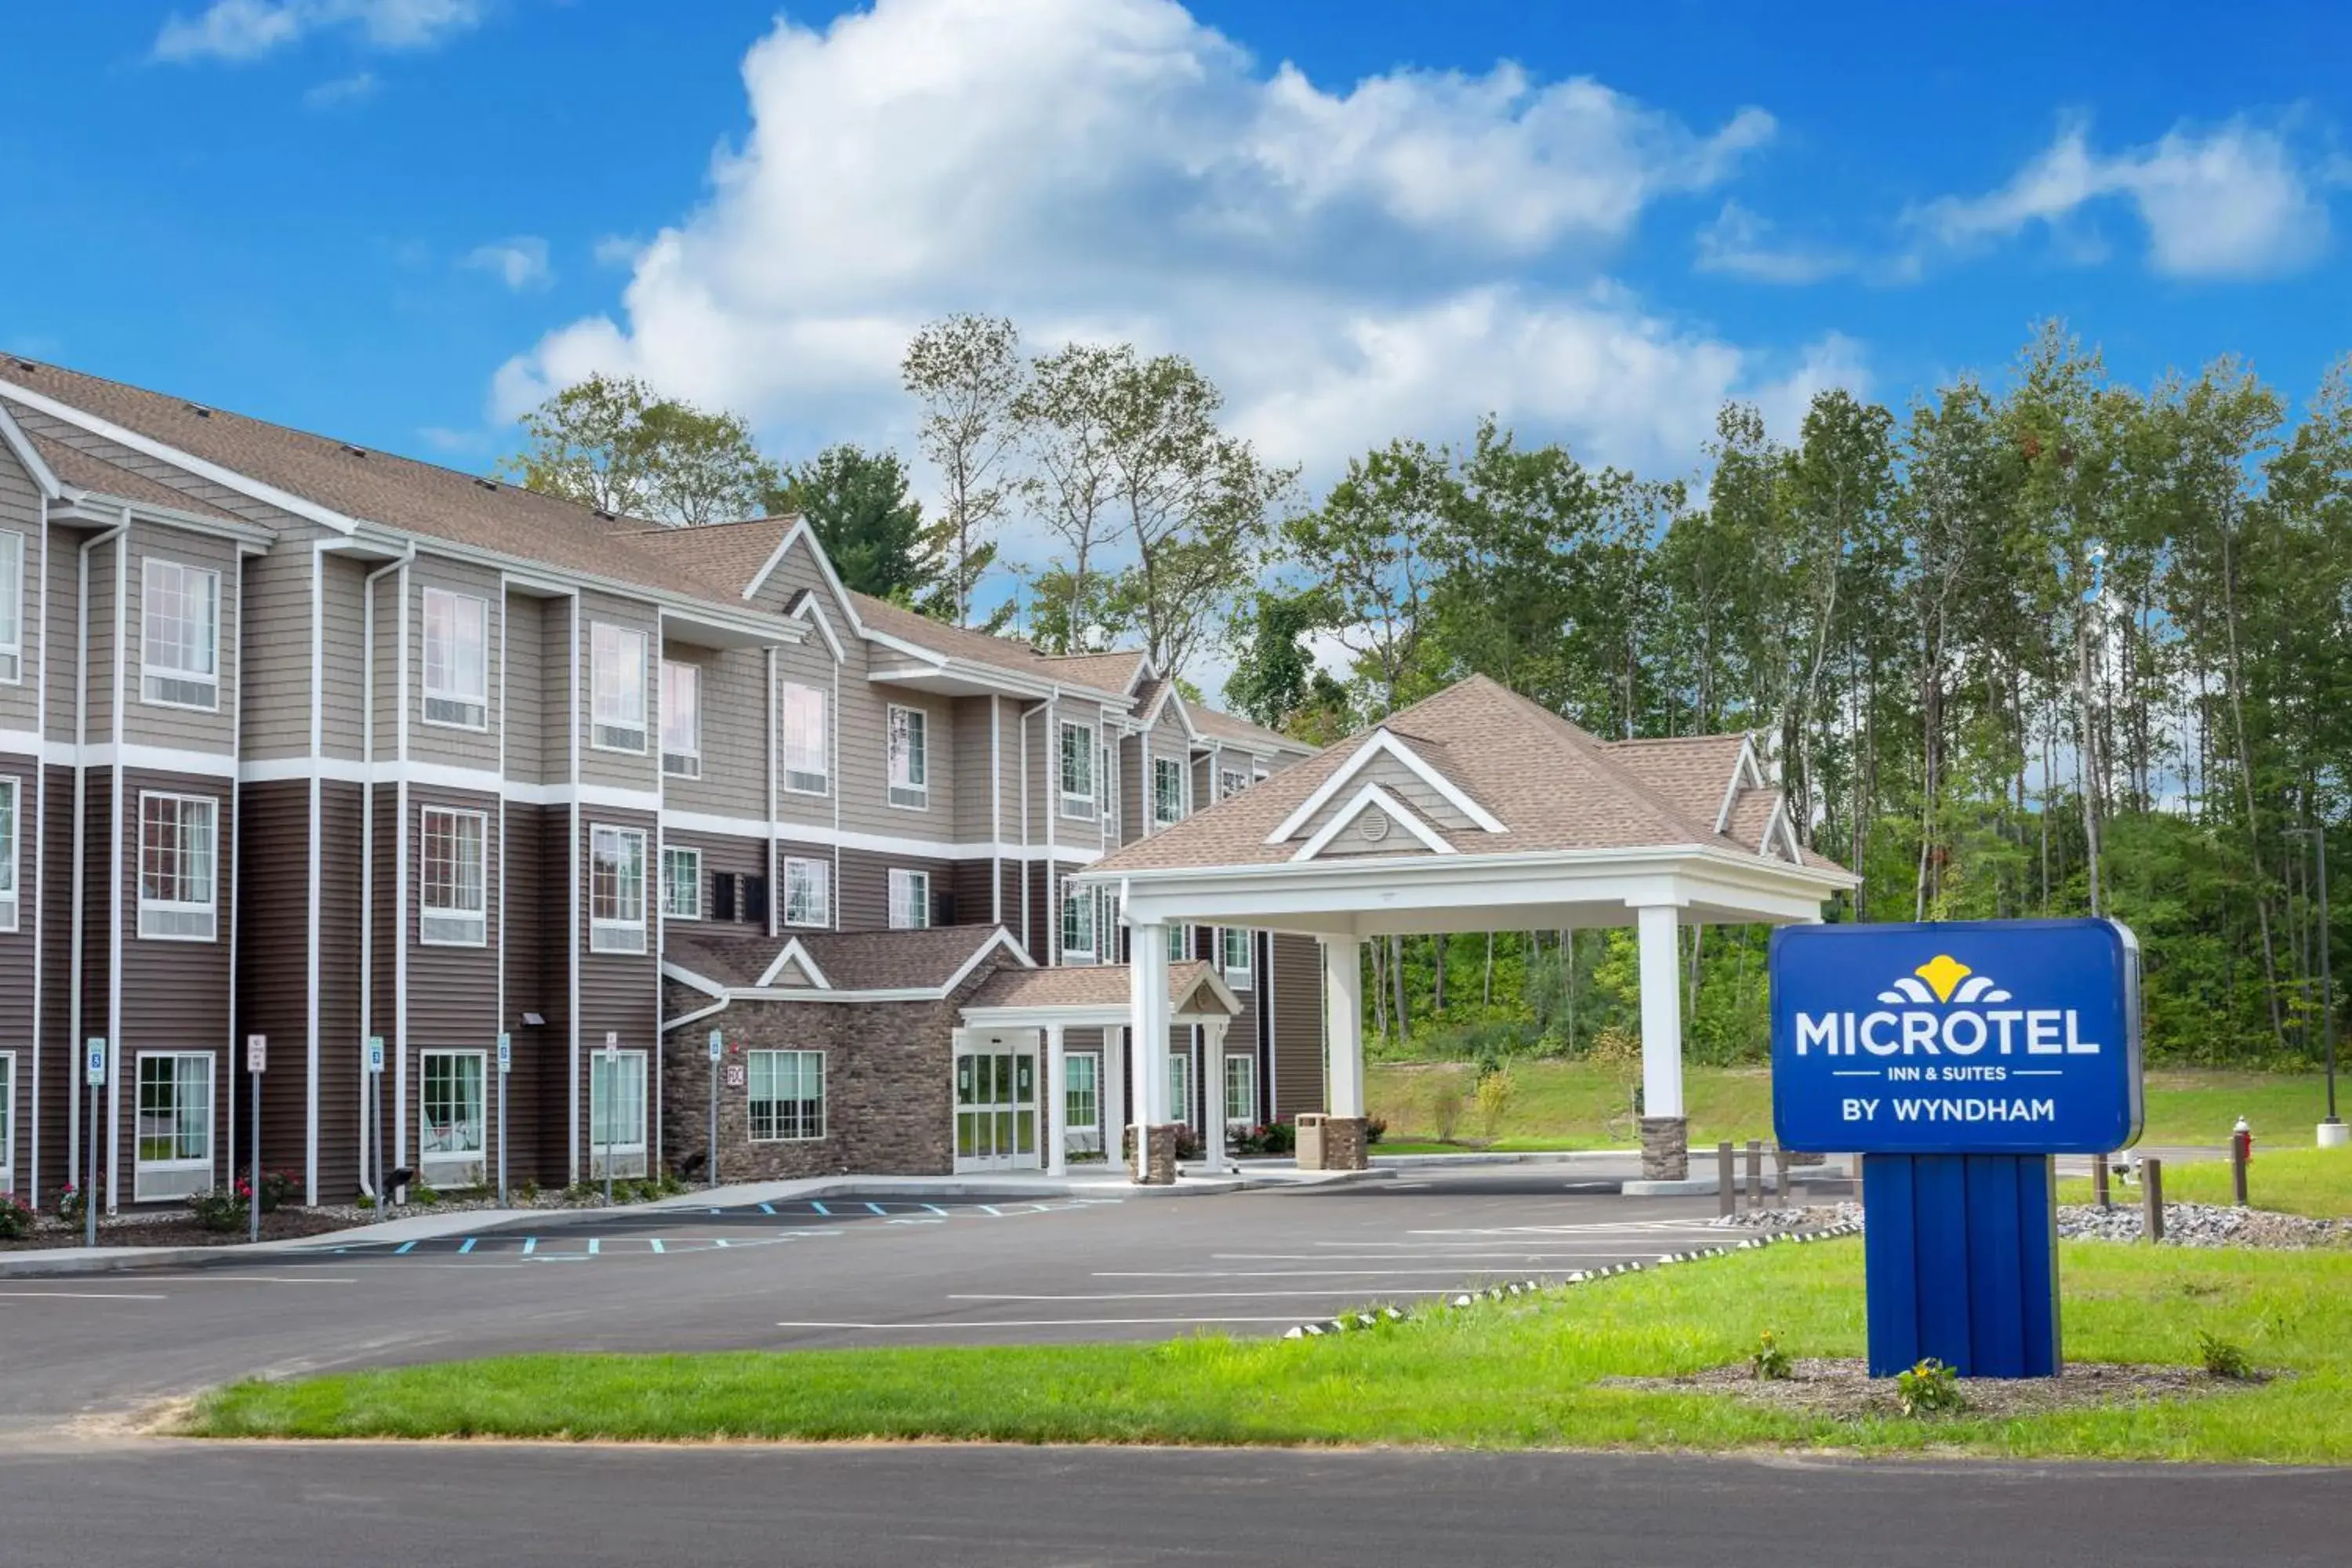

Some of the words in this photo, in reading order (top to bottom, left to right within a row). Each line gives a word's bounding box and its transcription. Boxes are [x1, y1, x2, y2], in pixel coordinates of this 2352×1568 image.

[1795, 1009, 2100, 1056] MICROTEL
[1887, 1067, 1921, 1081] INN
[1925, 1067, 1938, 1081] &
[1942, 1066, 2007, 1081] SUITES
[1842, 1098, 1880, 1121] BY
[1892, 1098, 2055, 1122] WYNDHAM
